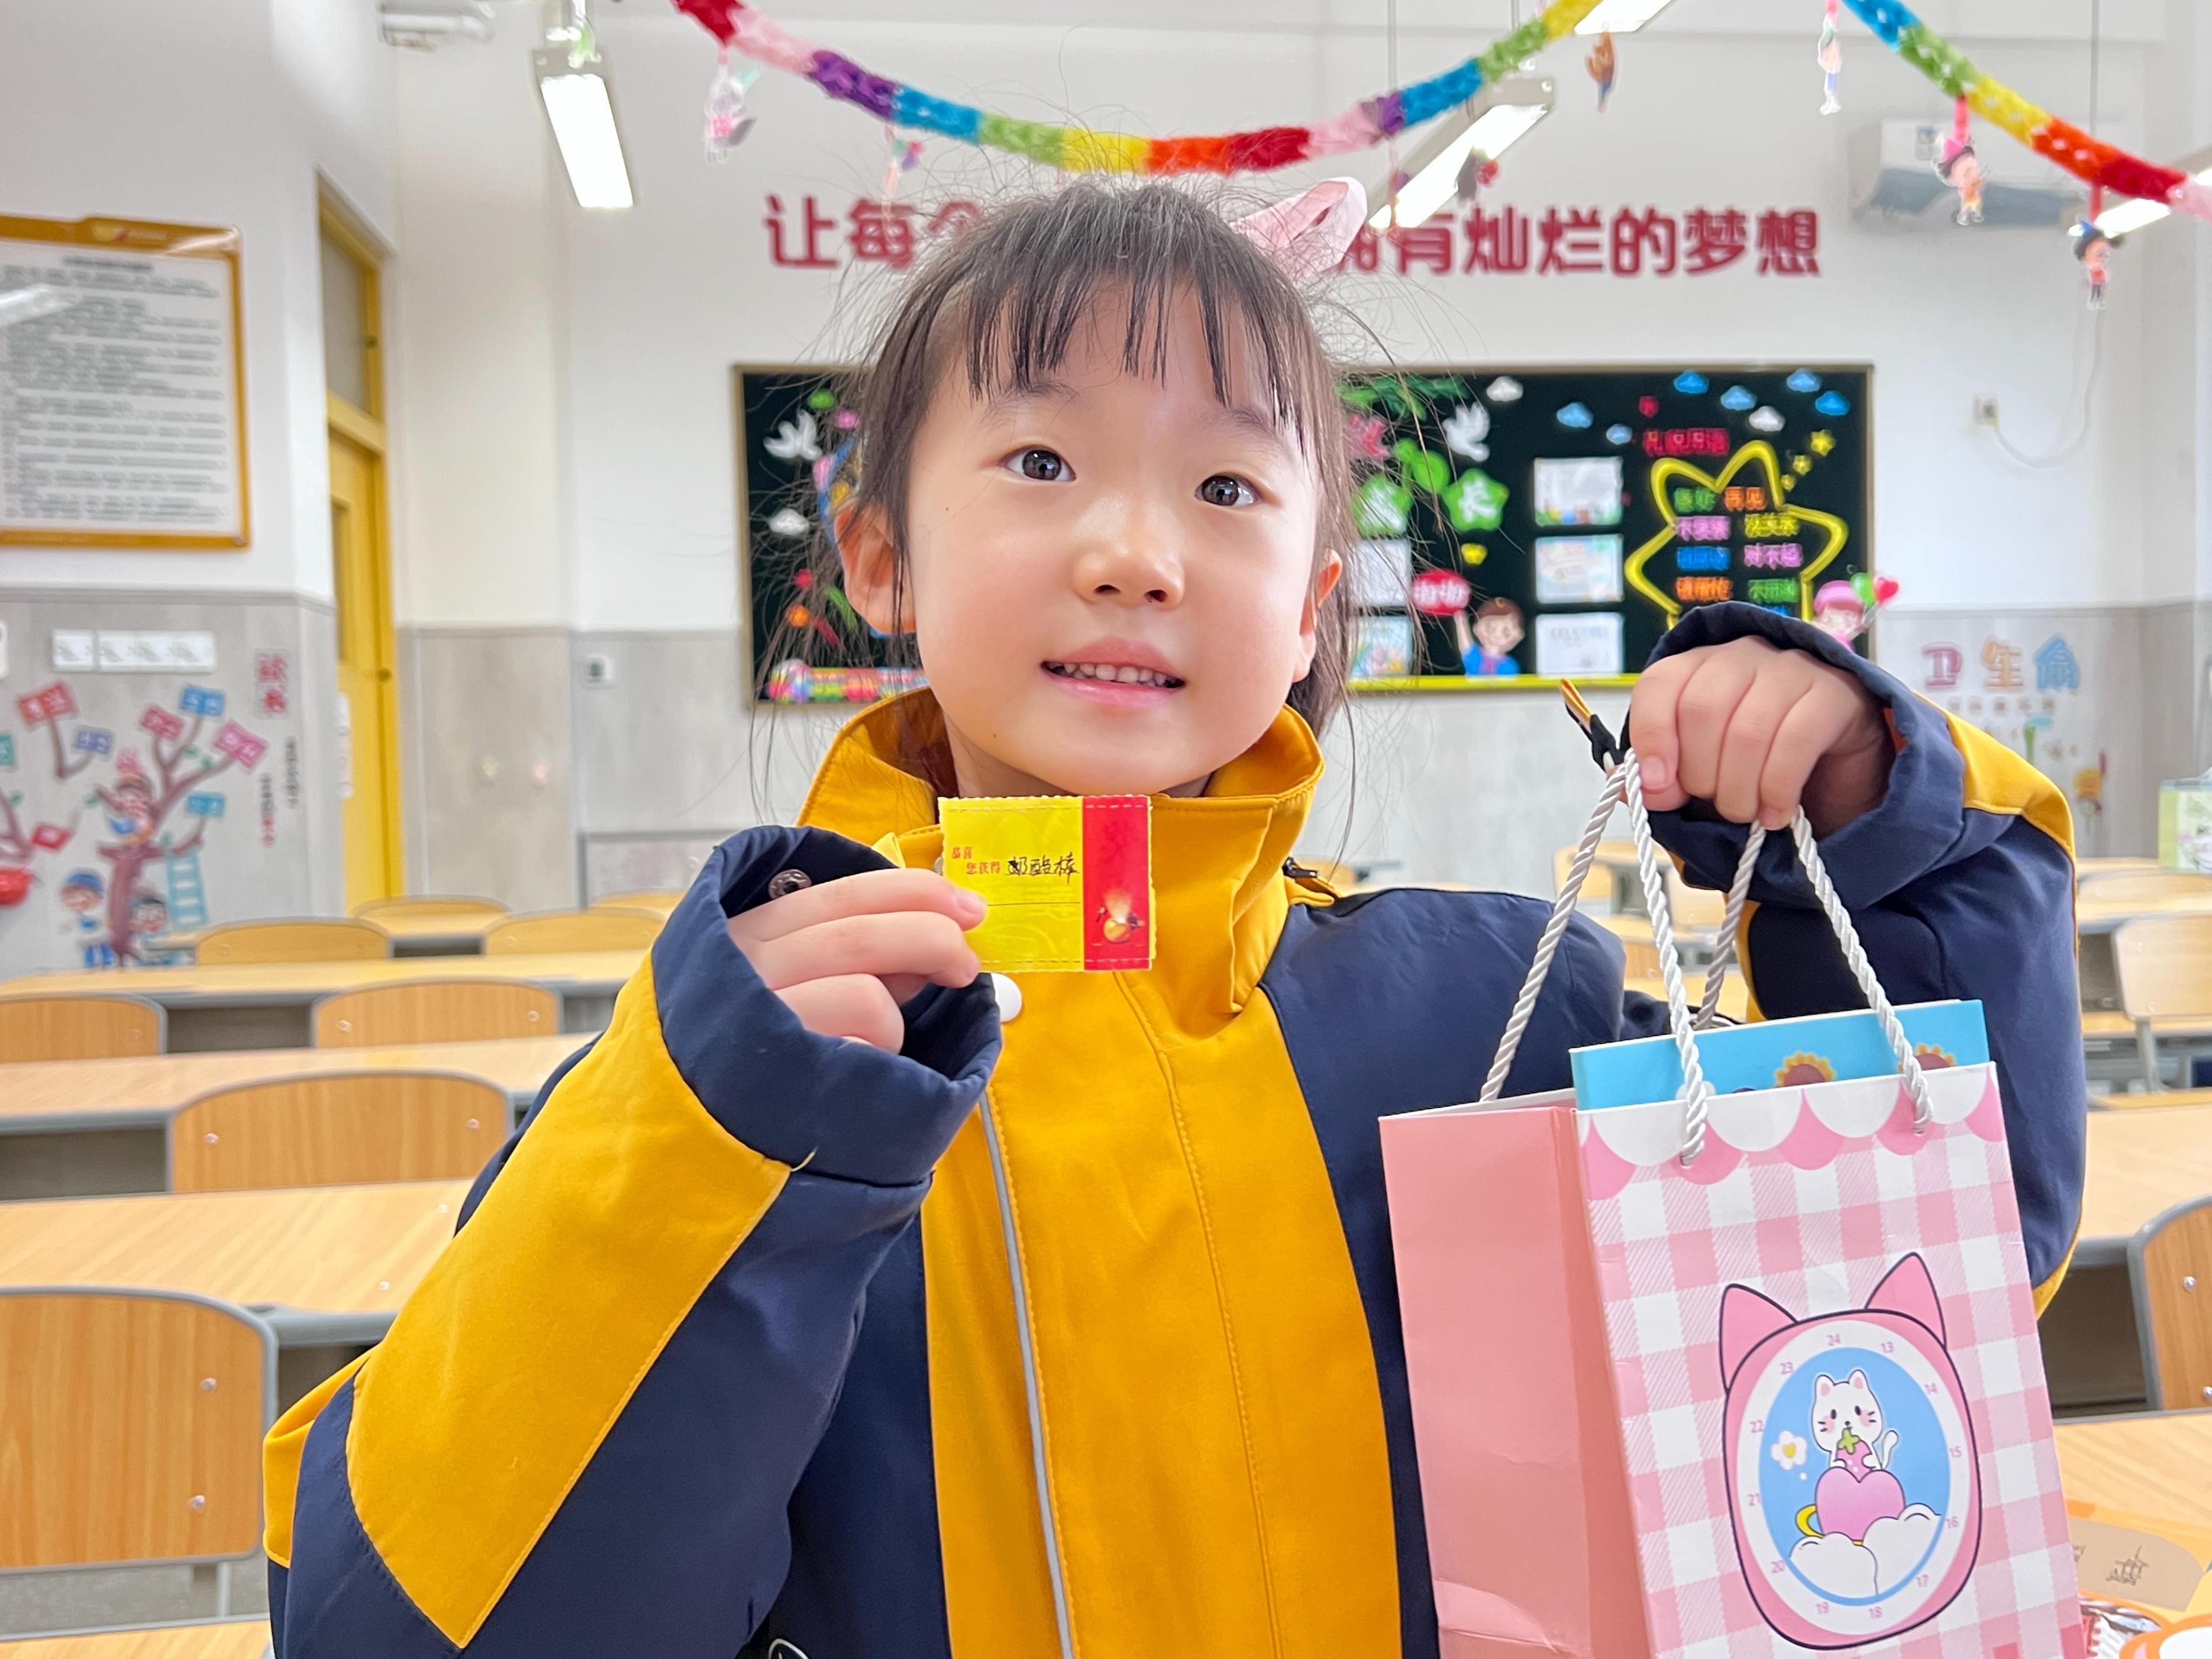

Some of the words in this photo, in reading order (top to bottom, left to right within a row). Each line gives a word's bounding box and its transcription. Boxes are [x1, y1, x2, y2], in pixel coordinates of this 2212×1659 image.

[1725, 486, 1767, 511] 再见
[1744, 543, 1803, 570] 对不起
[965, 861, 1002, 875] 您获得
[1827, 1334, 1841, 1346] 24
[1881, 1342, 1894, 1353] 13
[1780, 1362, 1794, 1374] 23
[1924, 1382, 1938, 1395] 14
[1749, 1420, 1764, 1433] 22
[1948, 1446, 1962, 1458] 15
[1748, 1493, 1761, 1506] 21
[1946, 1516, 1959, 1529] 16
[1771, 1561, 1785, 1573] 20
[1917, 1576, 1929, 1587] 17
[1817, 1602, 1829, 1614] 19
[1868, 1606, 1882, 1619] 18
